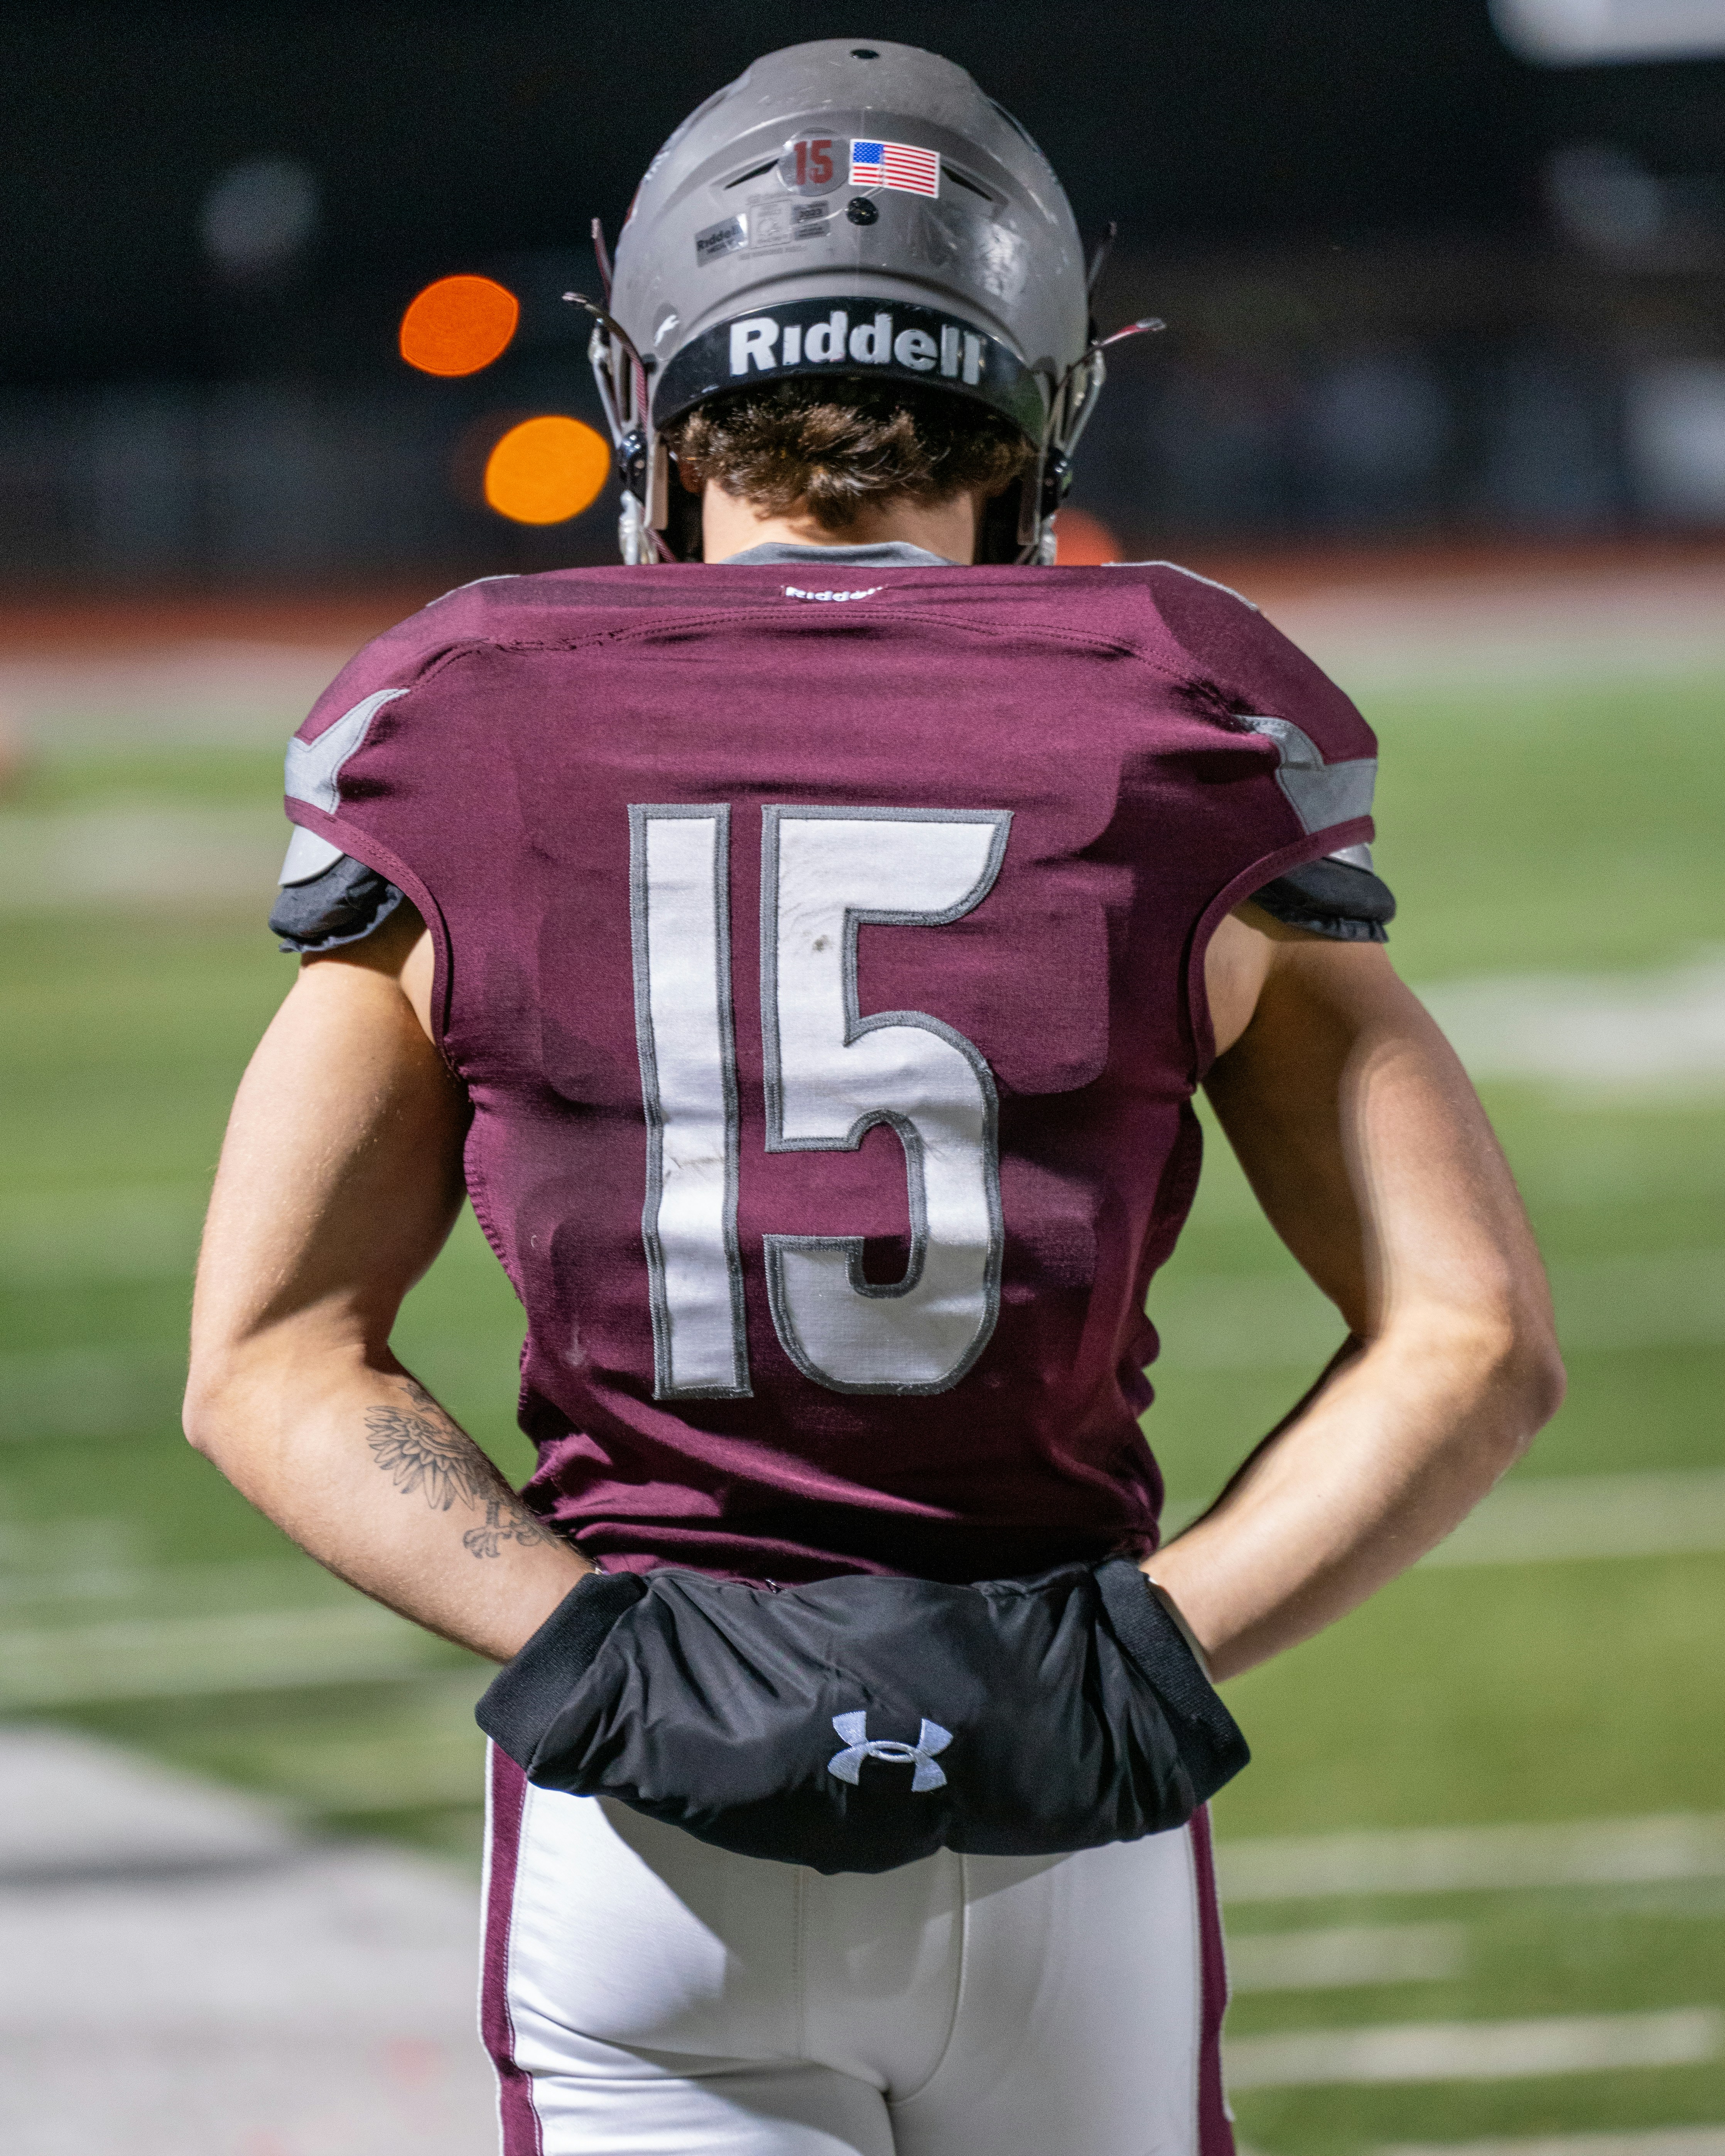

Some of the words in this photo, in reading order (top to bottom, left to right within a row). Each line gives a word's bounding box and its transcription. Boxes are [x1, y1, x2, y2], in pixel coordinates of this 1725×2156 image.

[794, 140, 833, 185] 15
[730, 310, 981, 385] Riddell
[628, 803, 1014, 1400] 15
